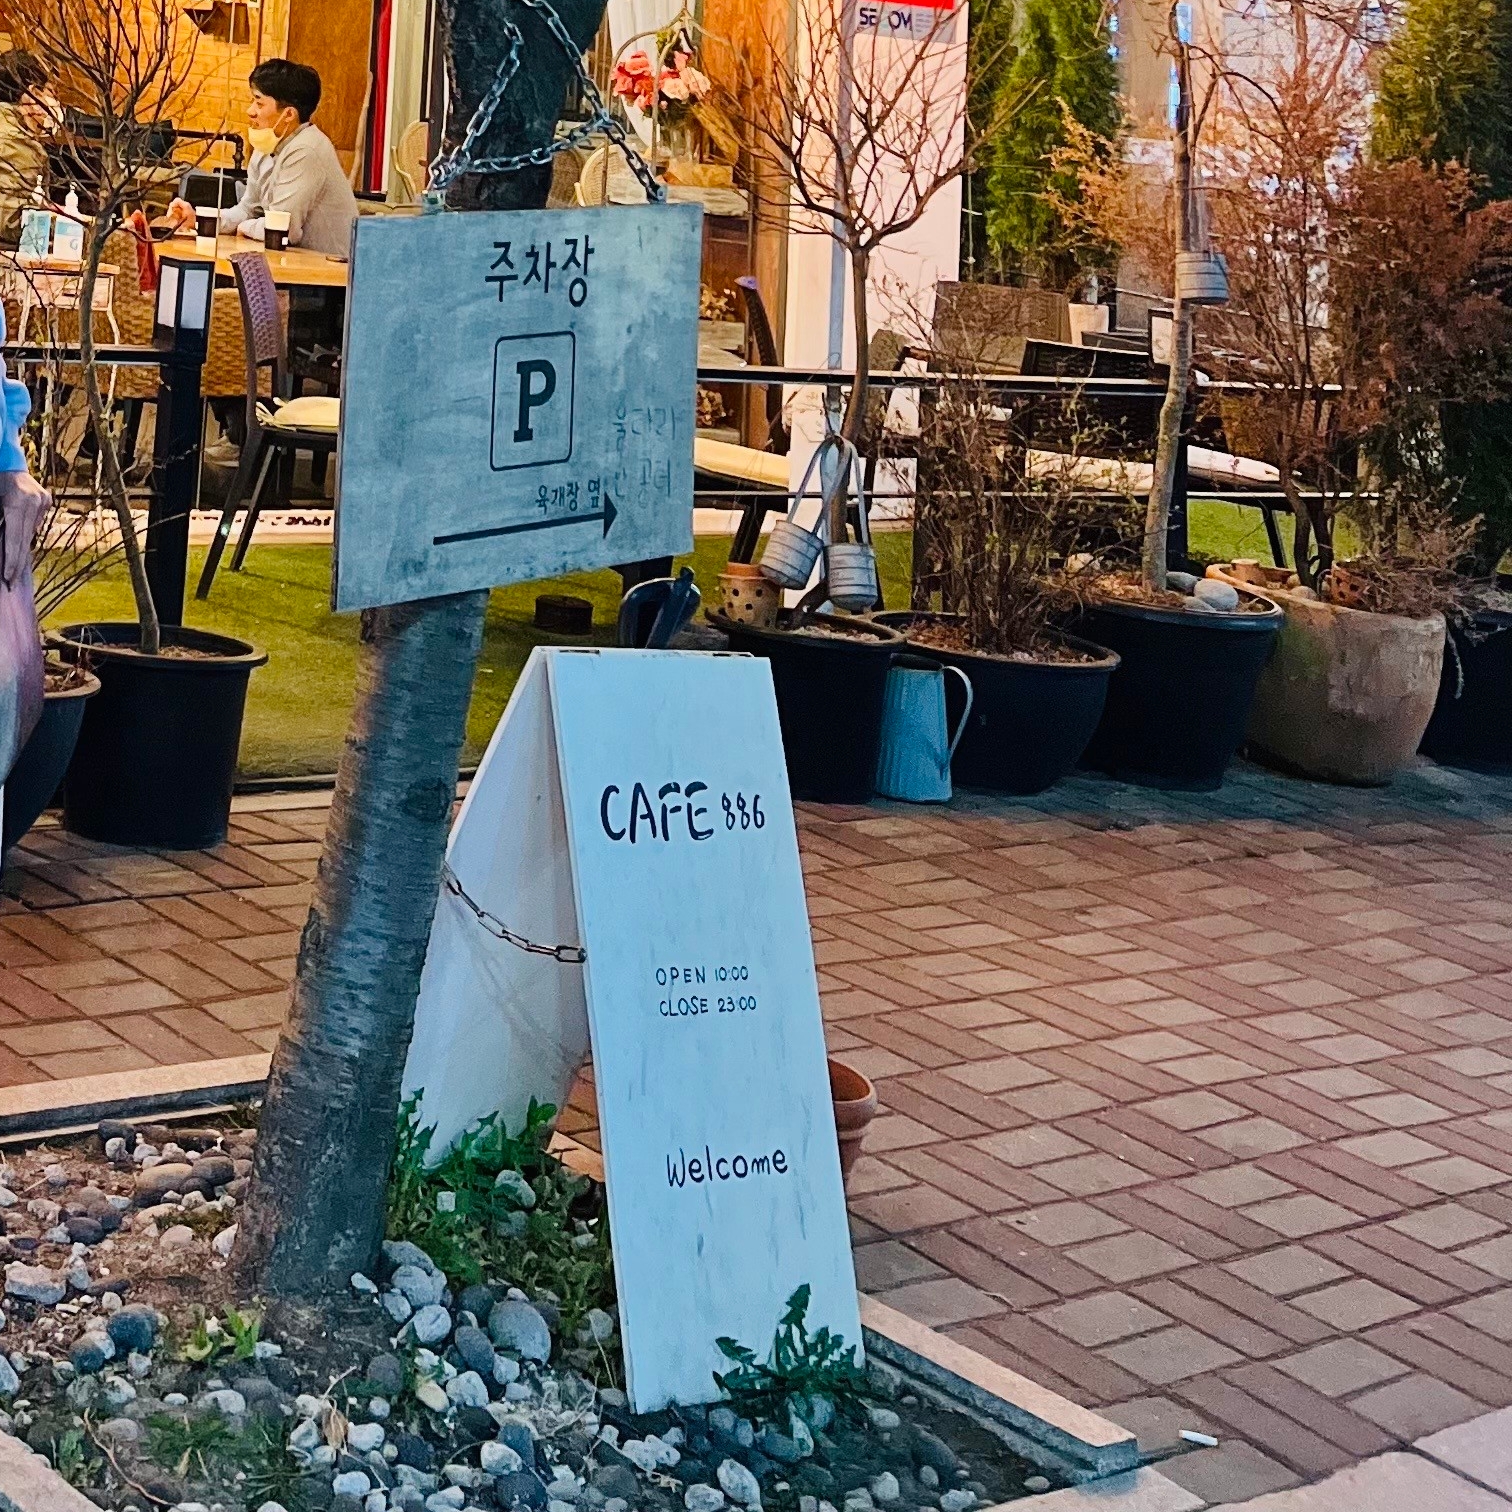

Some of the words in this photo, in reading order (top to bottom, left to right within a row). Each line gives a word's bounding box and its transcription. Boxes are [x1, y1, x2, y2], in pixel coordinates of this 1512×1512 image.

[485, 234, 595, 307] 주차장
[513, 359, 557, 443] P
[535, 481, 580, 515] 육개장
[588, 473, 601, 509] 옆
[600, 781, 715, 845] CAFE
[721, 791, 766, 832] 886
[655, 965, 706, 986] OPEN
[714, 965, 749, 982] 10:00
[659, 995, 709, 1017] CLOSE
[717, 995, 757, 1013] 23:00
[667, 1144, 789, 1188] Welcome
